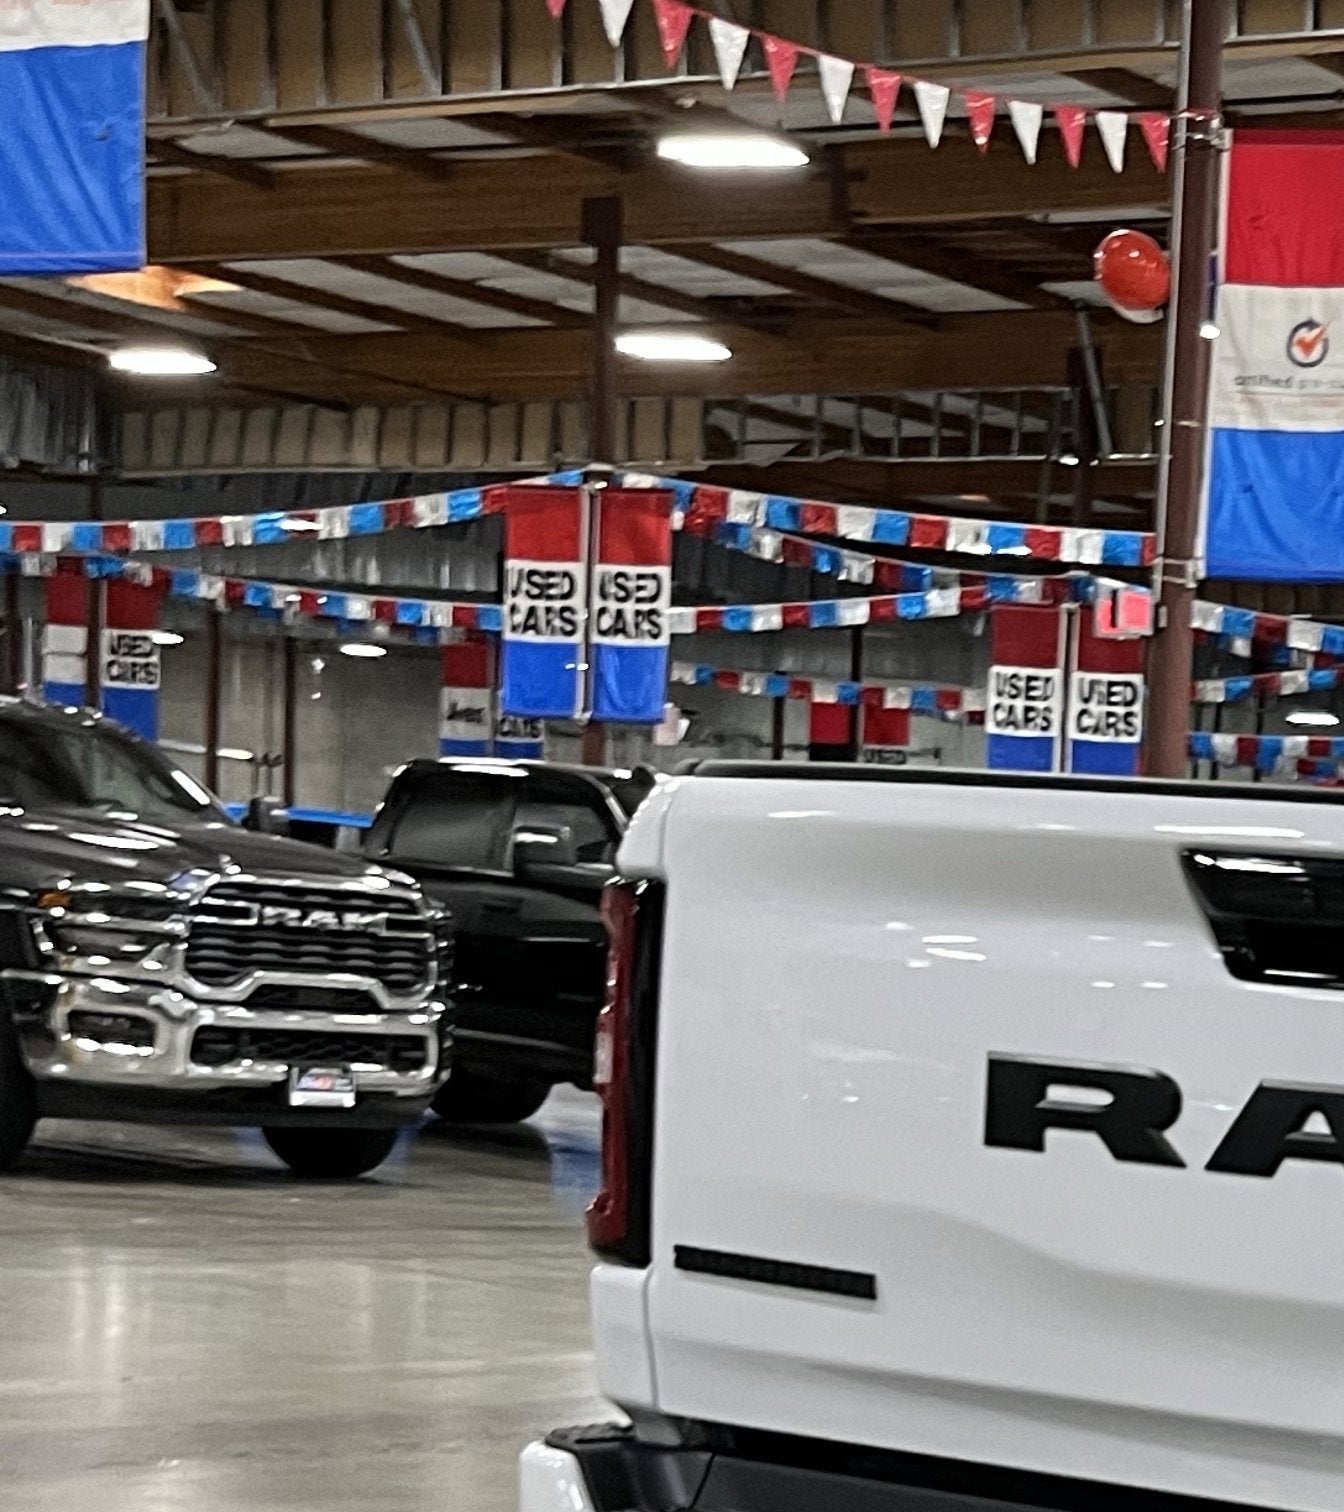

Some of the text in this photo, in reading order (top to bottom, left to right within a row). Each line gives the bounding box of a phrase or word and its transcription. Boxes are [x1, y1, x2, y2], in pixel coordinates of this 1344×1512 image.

[506, 568, 575, 600] USED
[600, 571, 662, 603] USED
[509, 603, 576, 637] CARS
[597, 605, 662, 639] CARS
[995, 671, 1054, 701] USED
[1079, 677, 1138, 707] USED
[993, 703, 1052, 731] CARS
[1076, 708, 1138, 737] CARS
[262, 906, 387, 934] RAM
